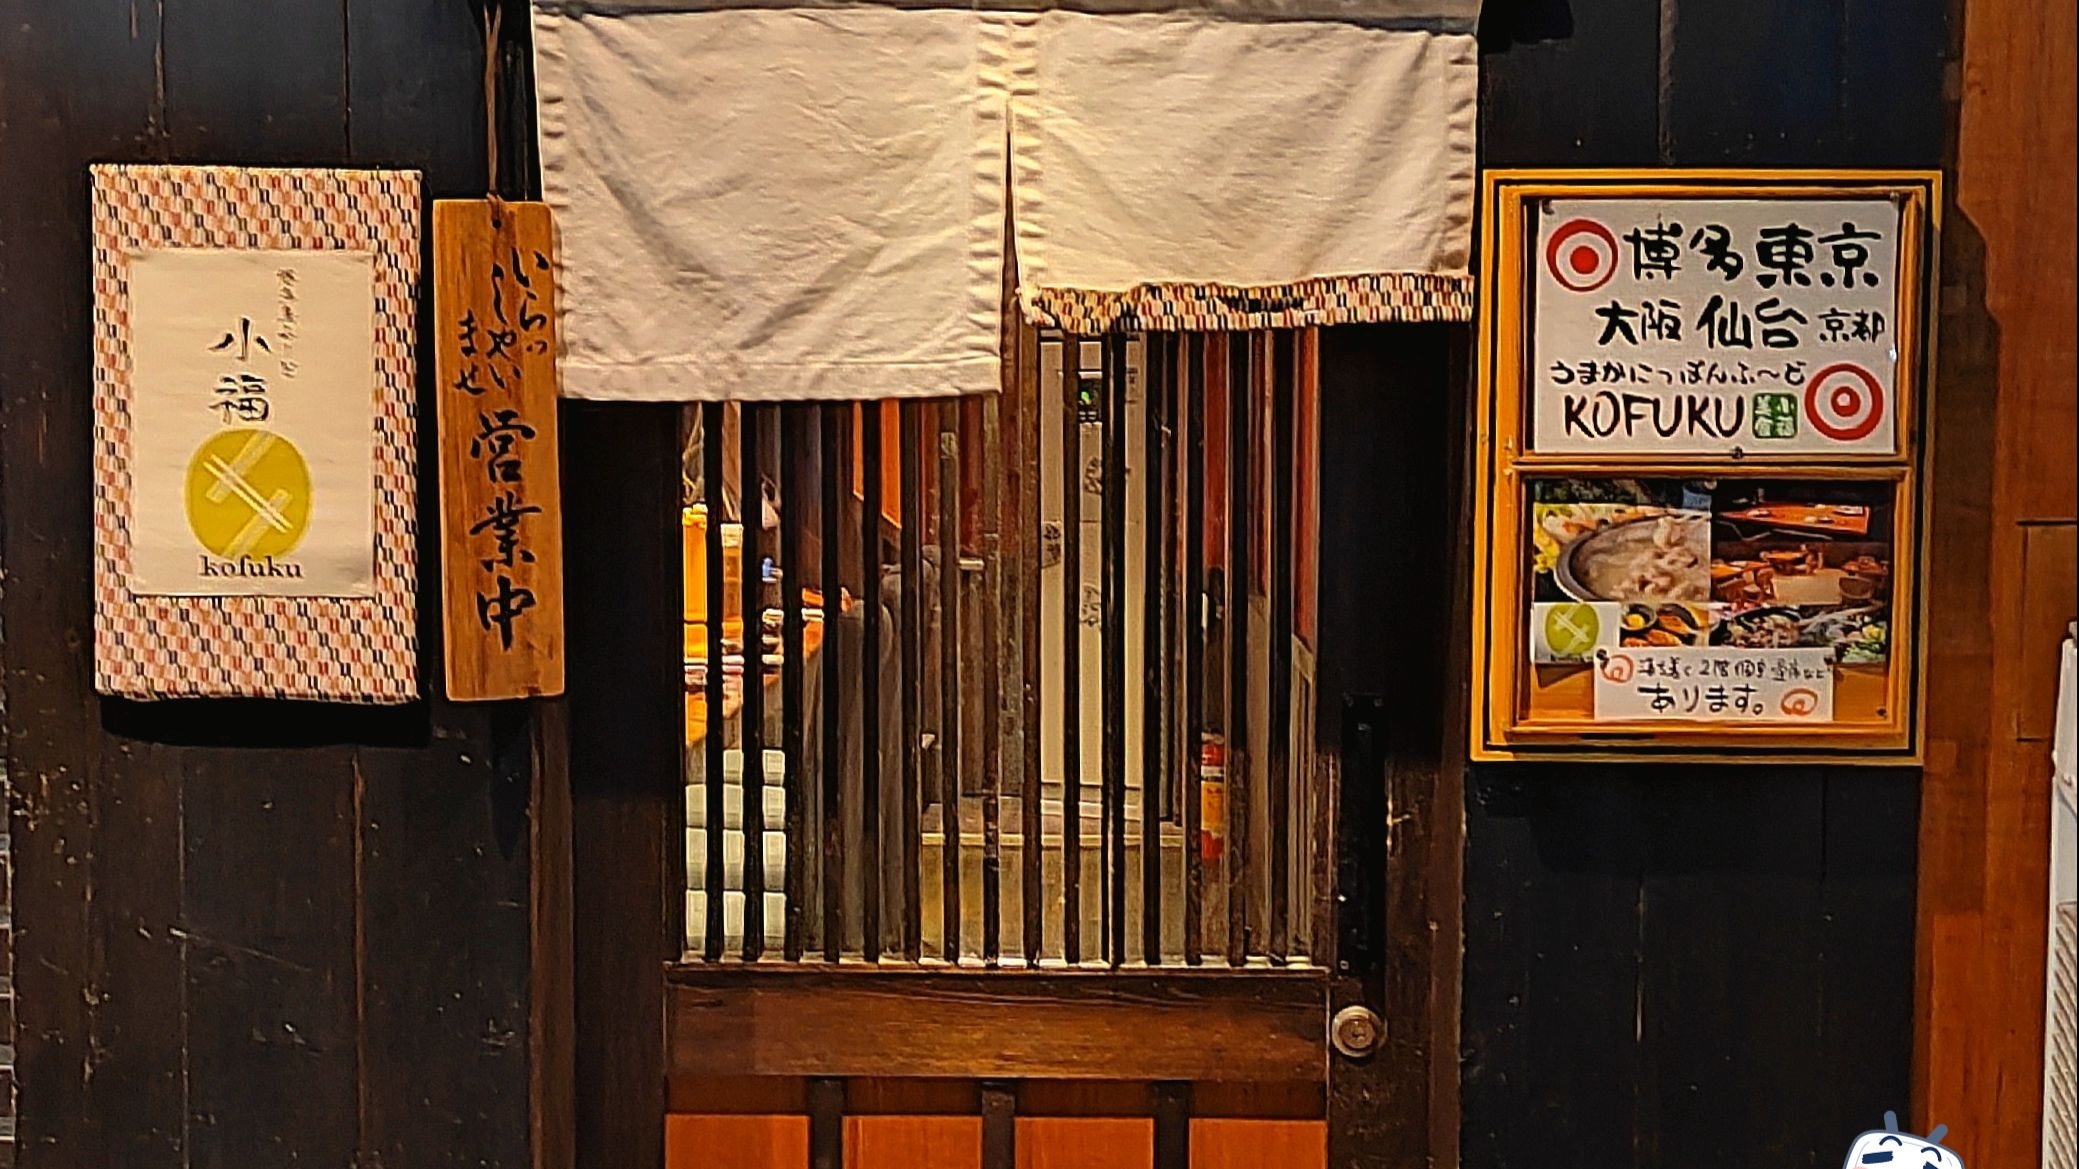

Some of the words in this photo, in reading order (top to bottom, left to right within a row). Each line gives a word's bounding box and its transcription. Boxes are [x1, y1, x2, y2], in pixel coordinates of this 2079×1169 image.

[1595, 299, 1681, 345] 大阪
[1696, 295, 1808, 349] 仙台
[1818, 307, 1886, 343] 京都
[1565, 391, 1744, 438] KOFUKU
[469, 409, 542, 650] 営業中
[199, 554, 303, 578] kofuku
[1637, 682, 1764, 715] あります。
